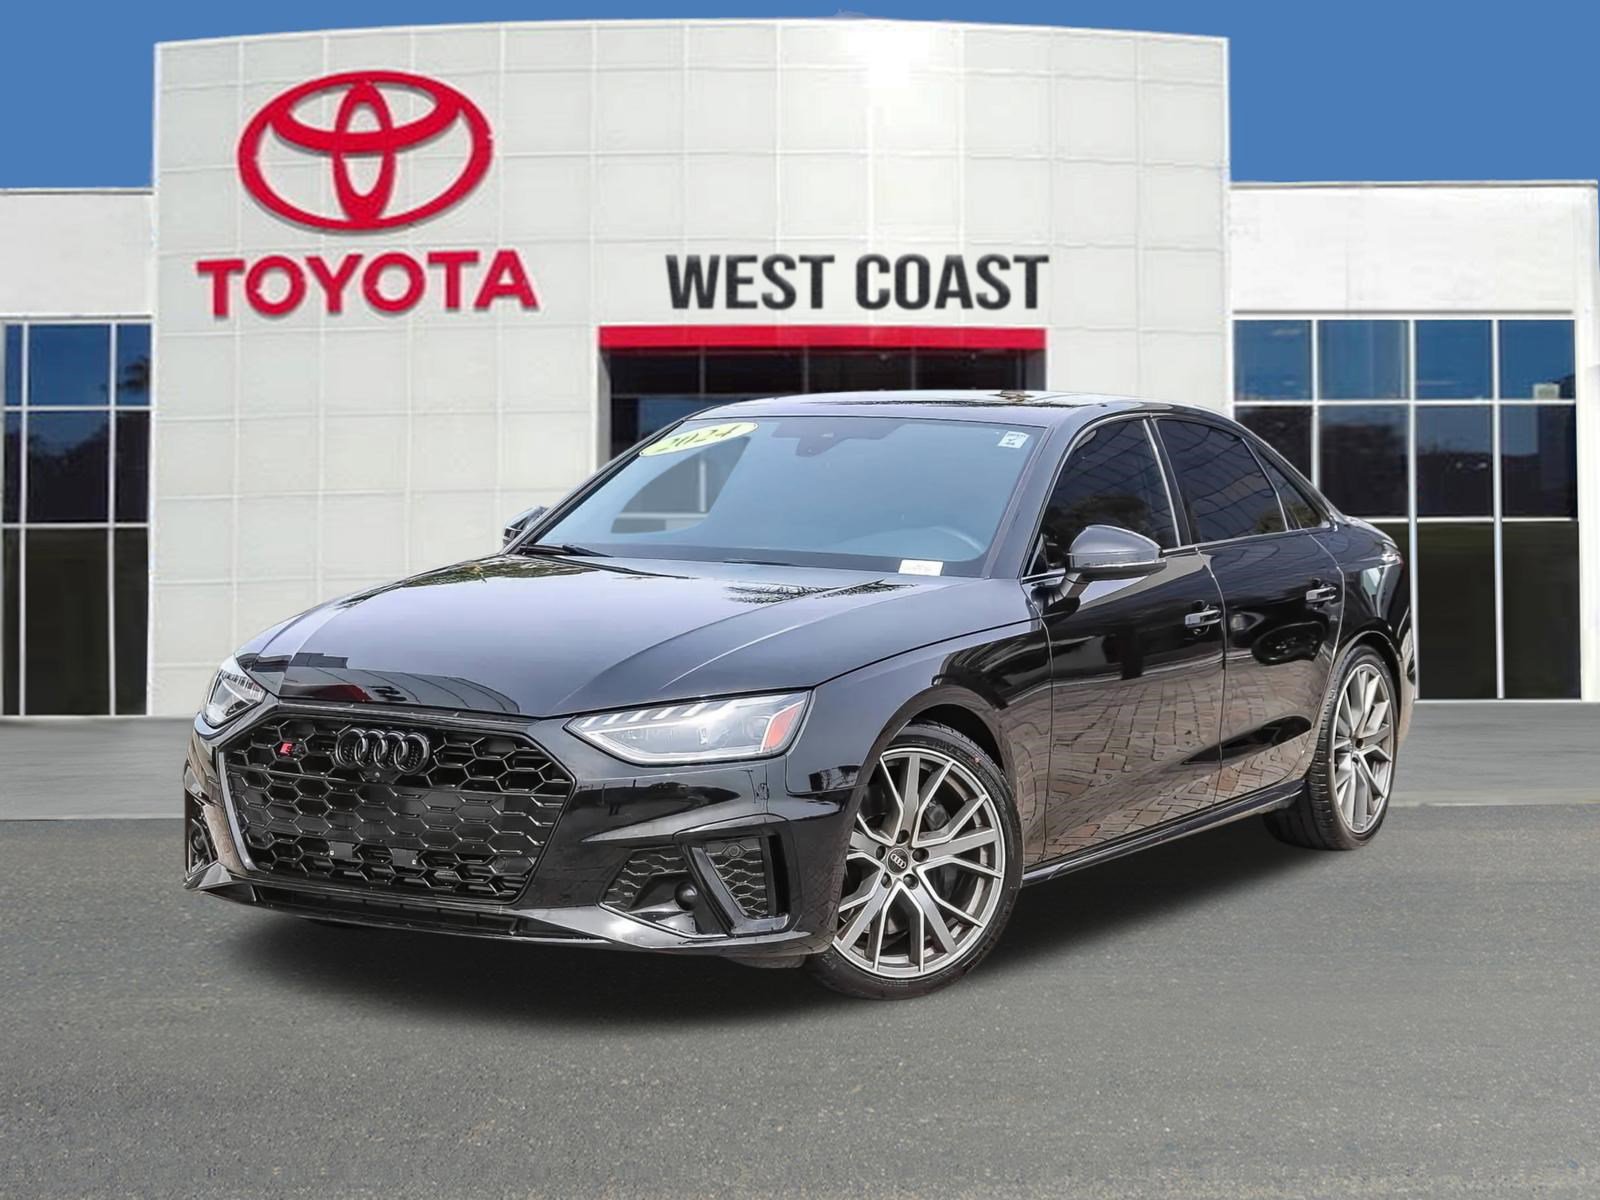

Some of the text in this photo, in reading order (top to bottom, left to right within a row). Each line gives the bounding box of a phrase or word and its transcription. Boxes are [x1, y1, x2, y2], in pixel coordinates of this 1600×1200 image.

[197, 249, 540, 317] TOYOTA
[666, 254, 1049, 310] WEST COAST
